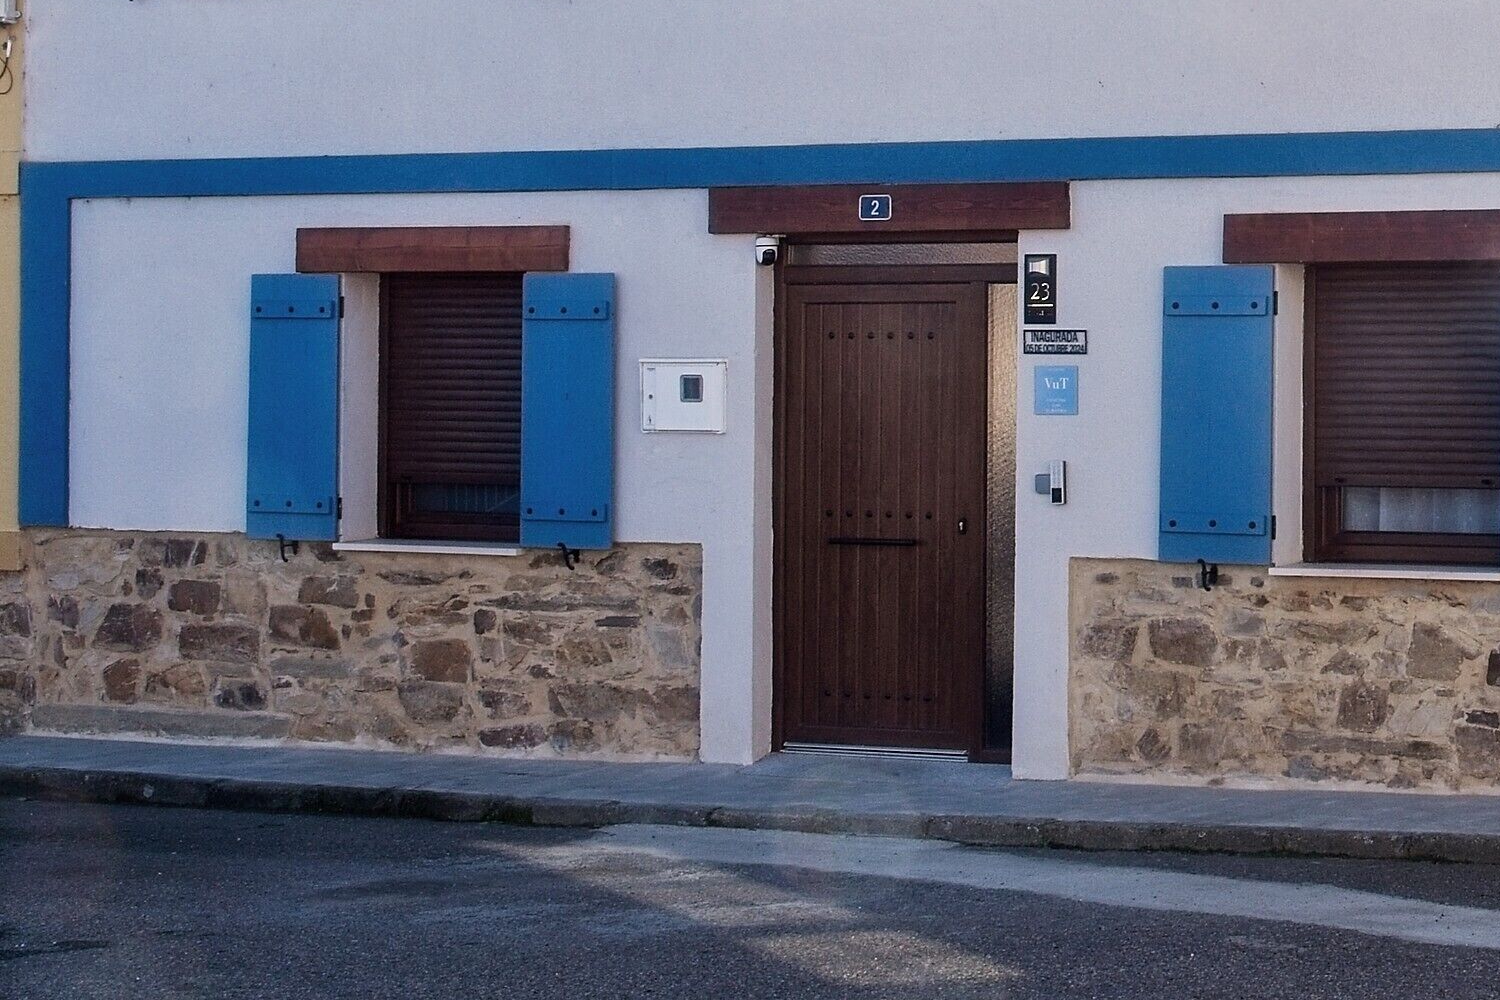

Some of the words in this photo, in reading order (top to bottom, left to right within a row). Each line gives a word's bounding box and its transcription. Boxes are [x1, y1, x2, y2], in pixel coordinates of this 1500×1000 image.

[871, 200, 880, 216] 2
[1030, 282, 1050, 301] 23
[1030, 331, 1079, 343] INAGURADA
[1044, 377, 1069, 390] VuT
